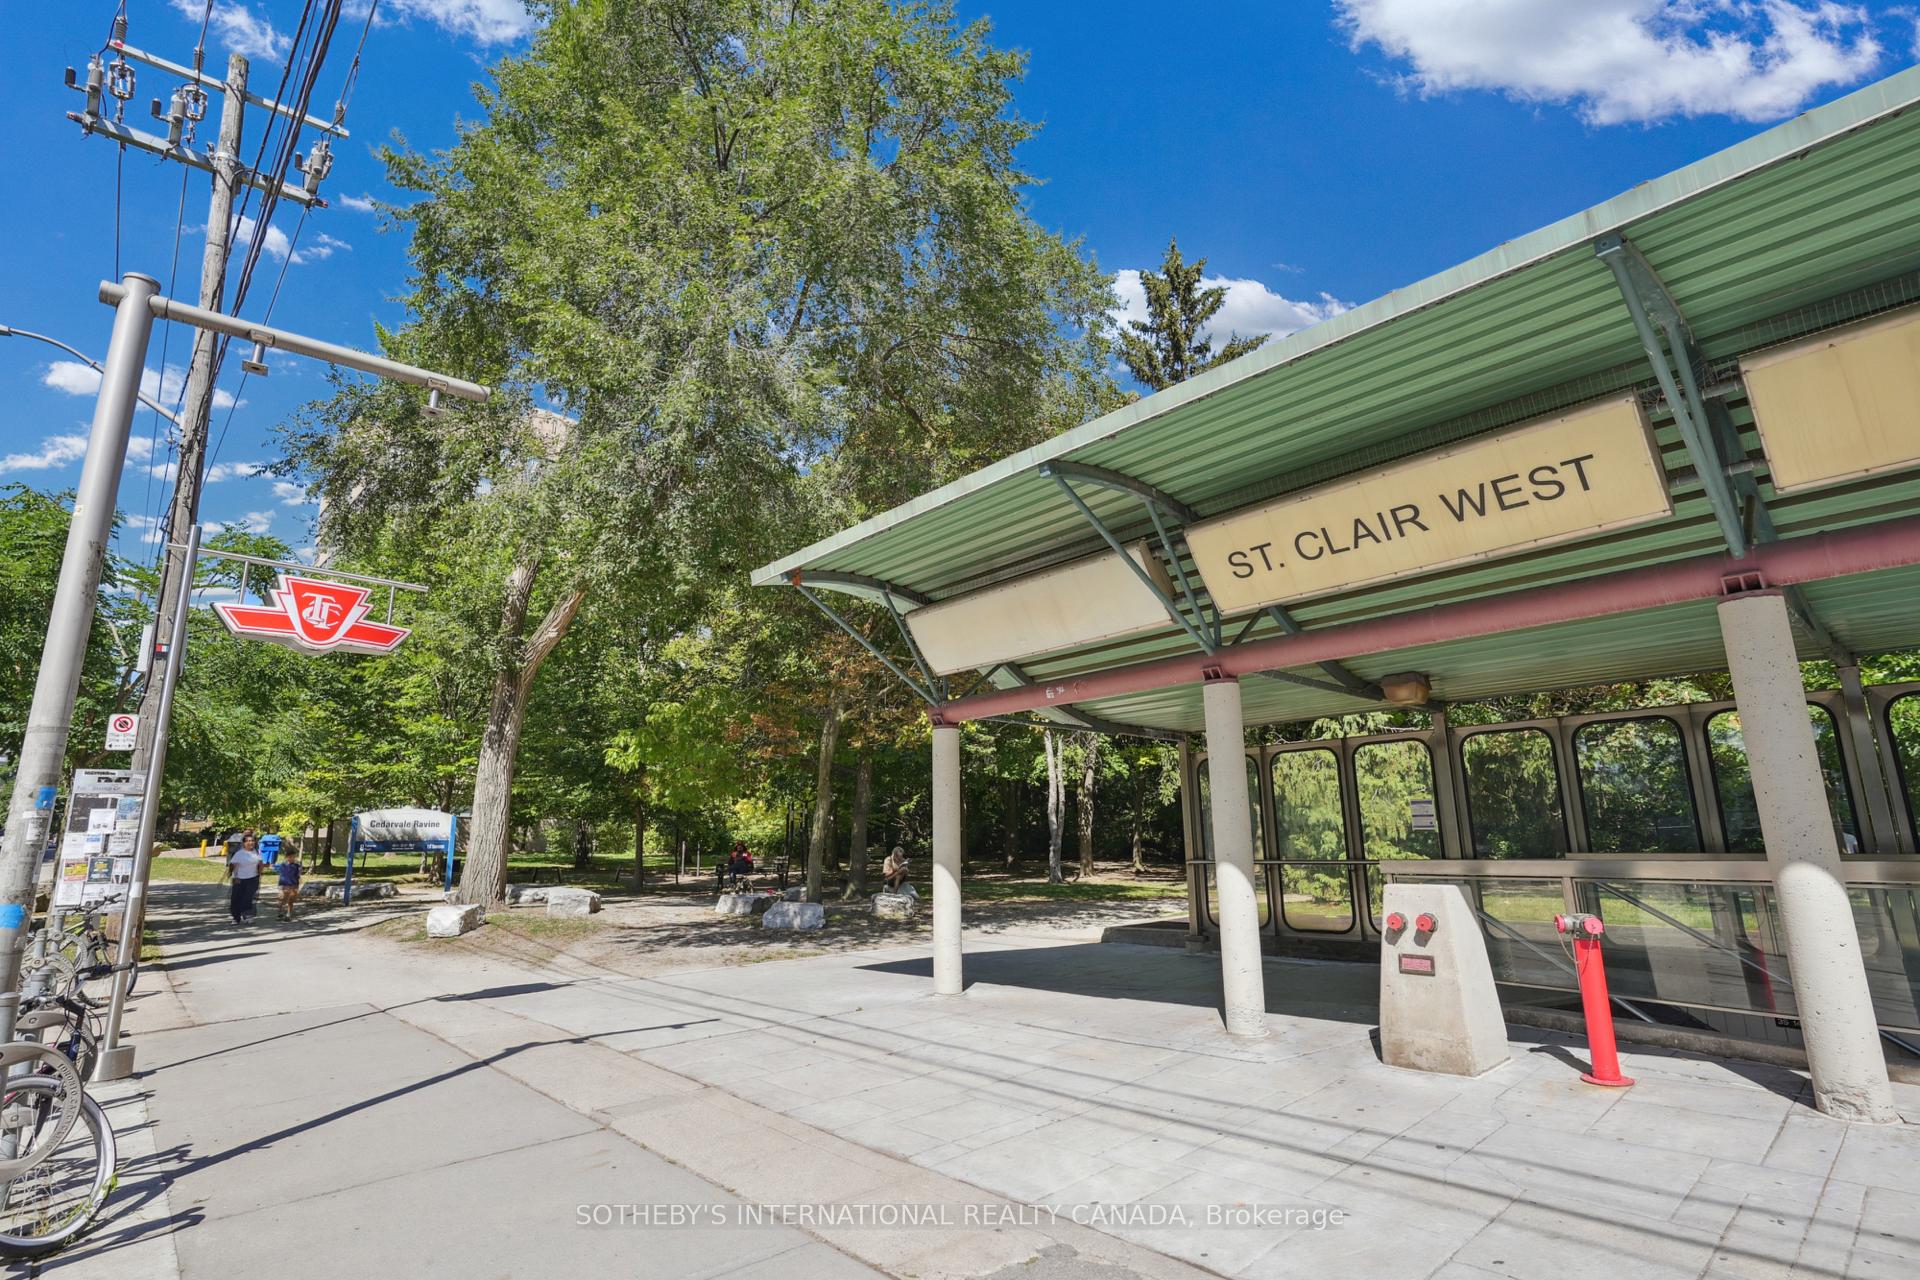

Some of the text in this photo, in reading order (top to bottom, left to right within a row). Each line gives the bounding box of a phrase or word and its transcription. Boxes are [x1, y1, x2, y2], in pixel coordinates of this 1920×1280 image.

[1227, 453, 1594, 579] ST. CLAIR WEST
[301, 592, 343, 630] TTC
[370, 819, 441, 828] Cedarvale Ravine
